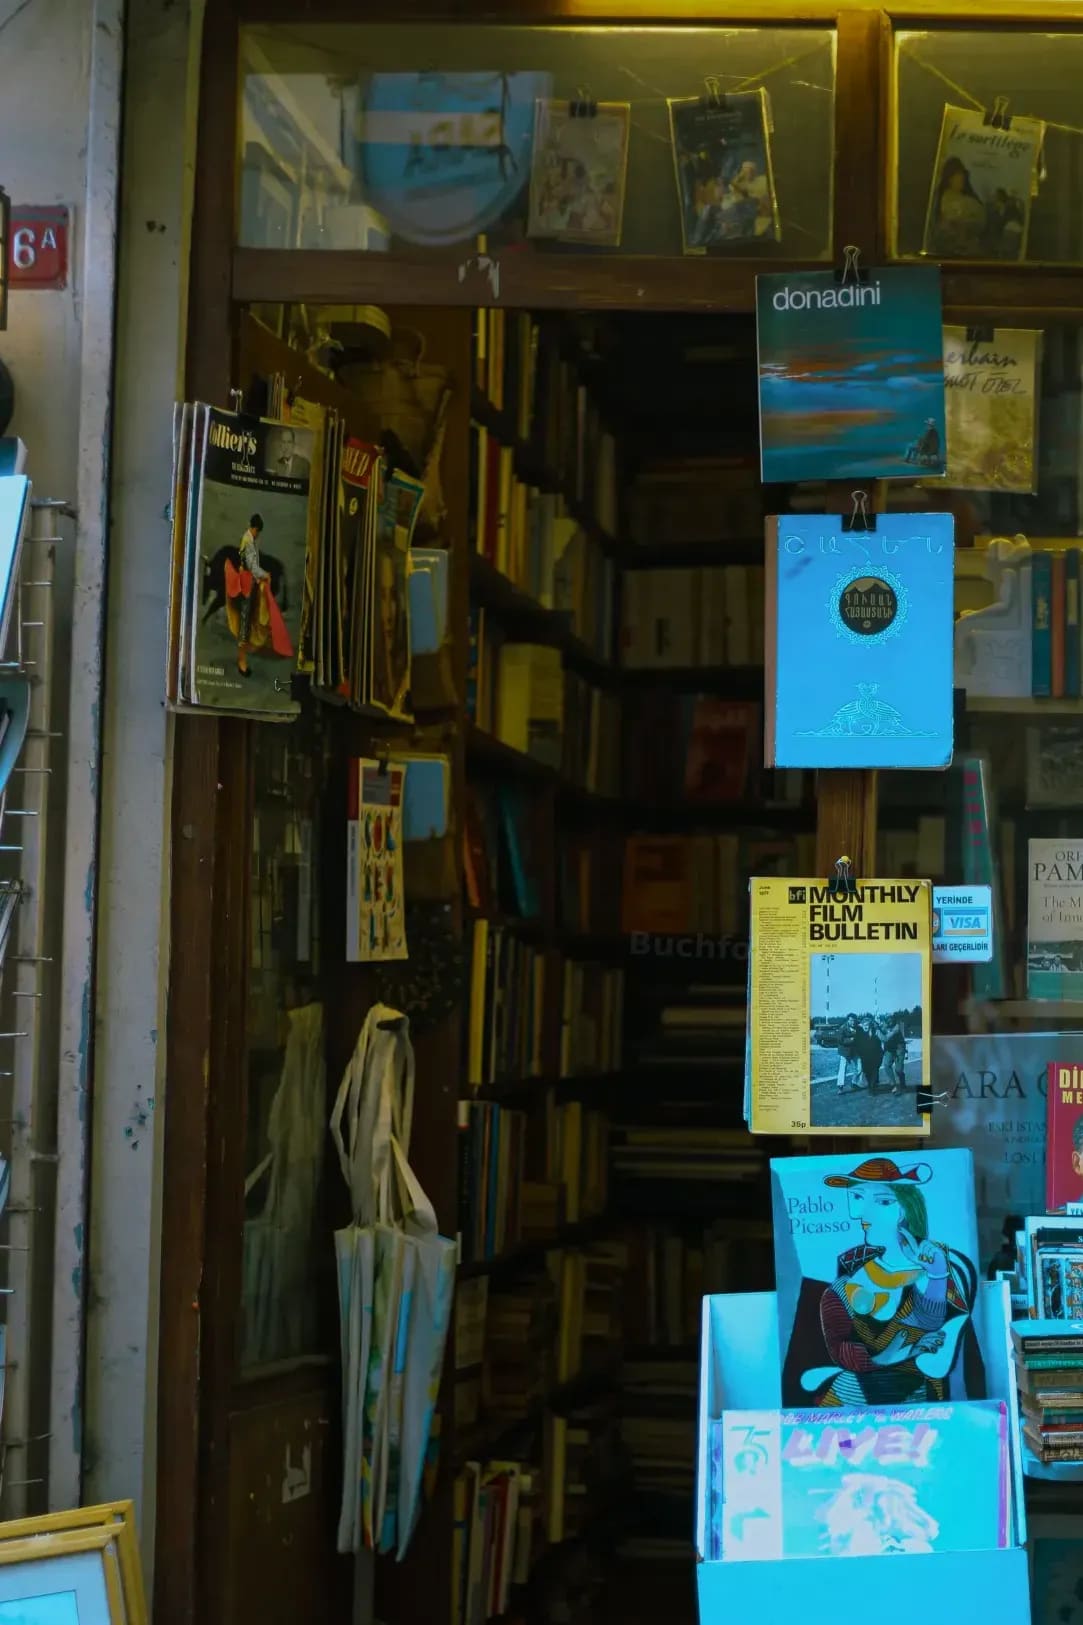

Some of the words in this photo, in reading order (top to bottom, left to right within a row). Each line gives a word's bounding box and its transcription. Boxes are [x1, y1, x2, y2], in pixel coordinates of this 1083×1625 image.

[772, 281, 881, 311] donadini
[809, 885, 920, 904] MONTHLY
[936, 894, 973, 904] YERİNDE
[809, 905, 863, 922] FILM
[950, 916, 981, 929] VISA
[809, 923, 918, 941] BULLETIN
[952, 1069, 1026, 1099] ARA
[788, 1195, 834, 1214] Pablo
[790, 1218, 851, 1234] Picasso
[782, 1424, 938, 1467] LIVE!
